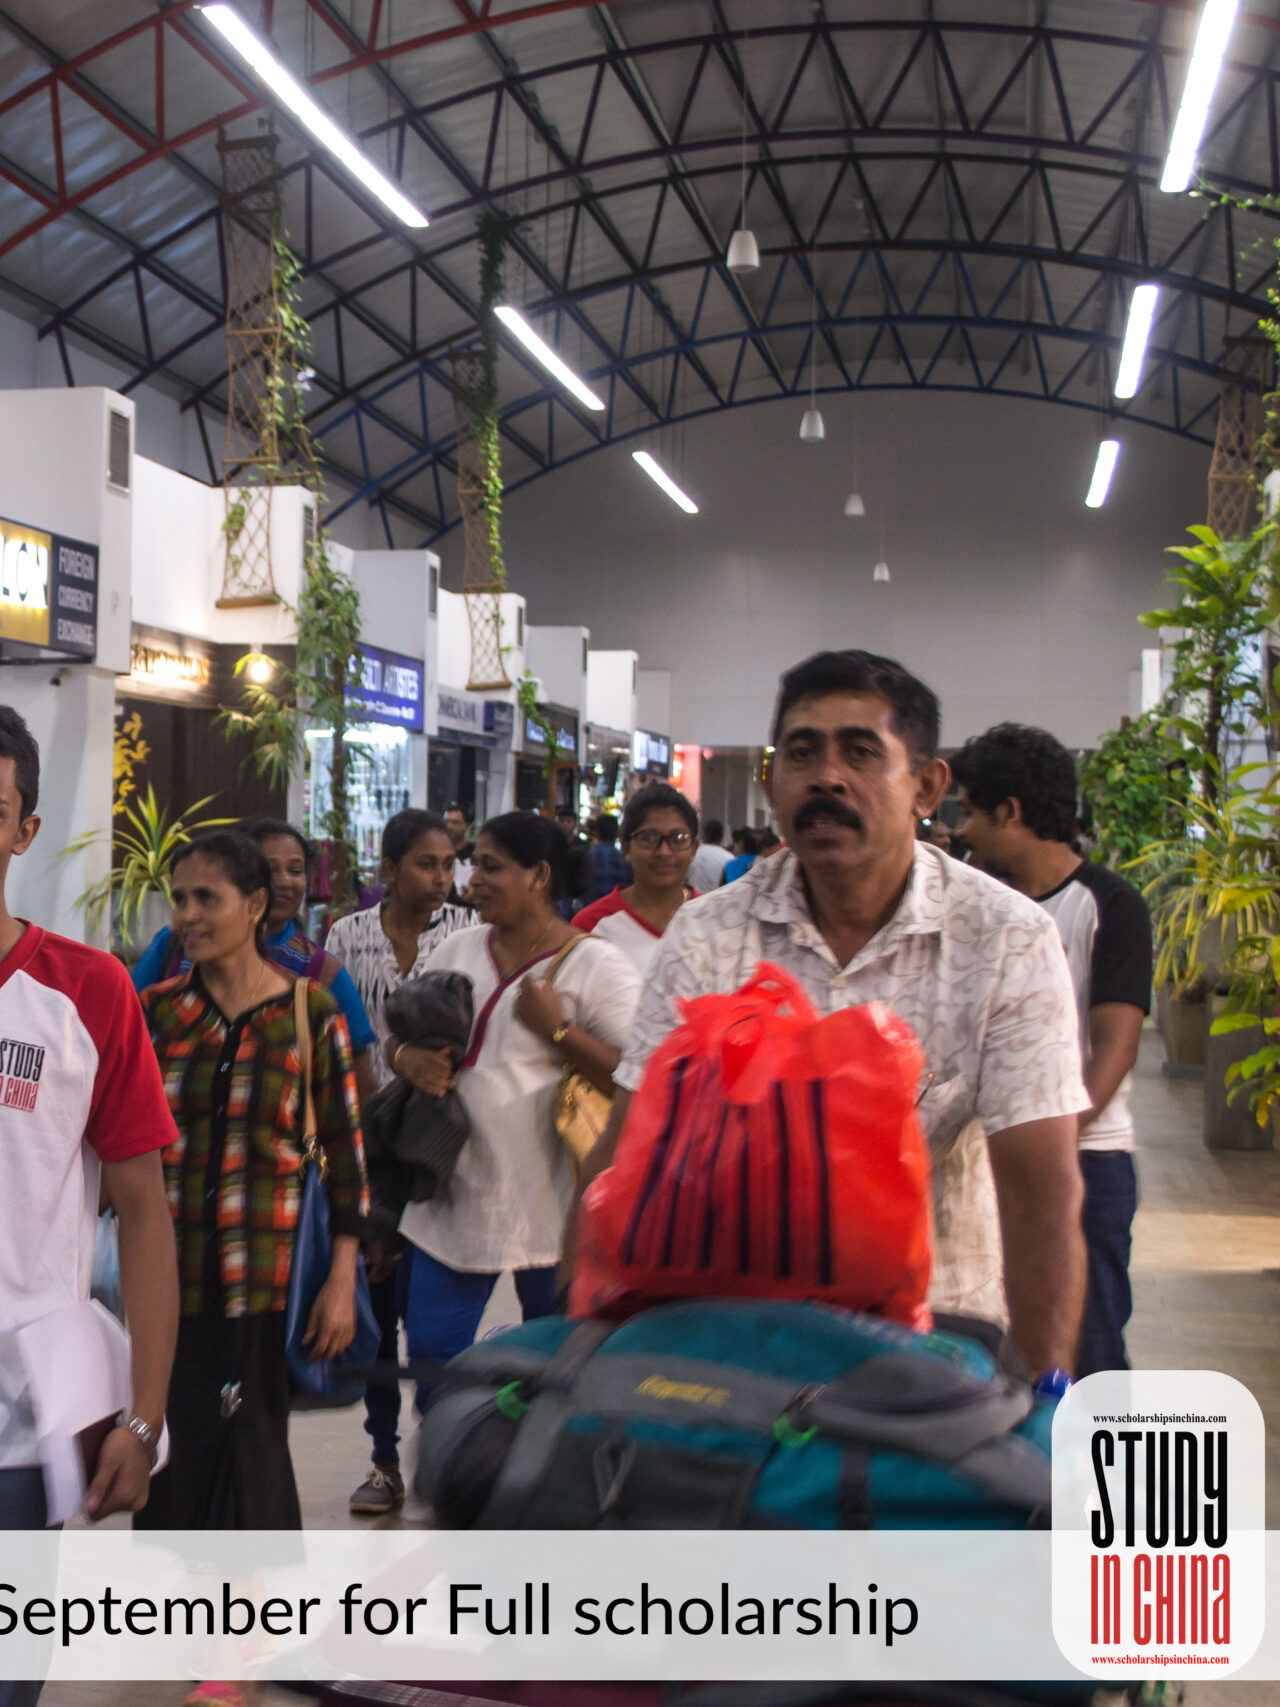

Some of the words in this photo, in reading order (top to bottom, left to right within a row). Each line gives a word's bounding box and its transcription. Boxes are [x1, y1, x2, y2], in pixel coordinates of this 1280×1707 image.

[59, 546, 95, 581] FOREIGN
[58, 585, 93, 613] CURRENCY
[57, 618, 93, 646] EXCHANGE
